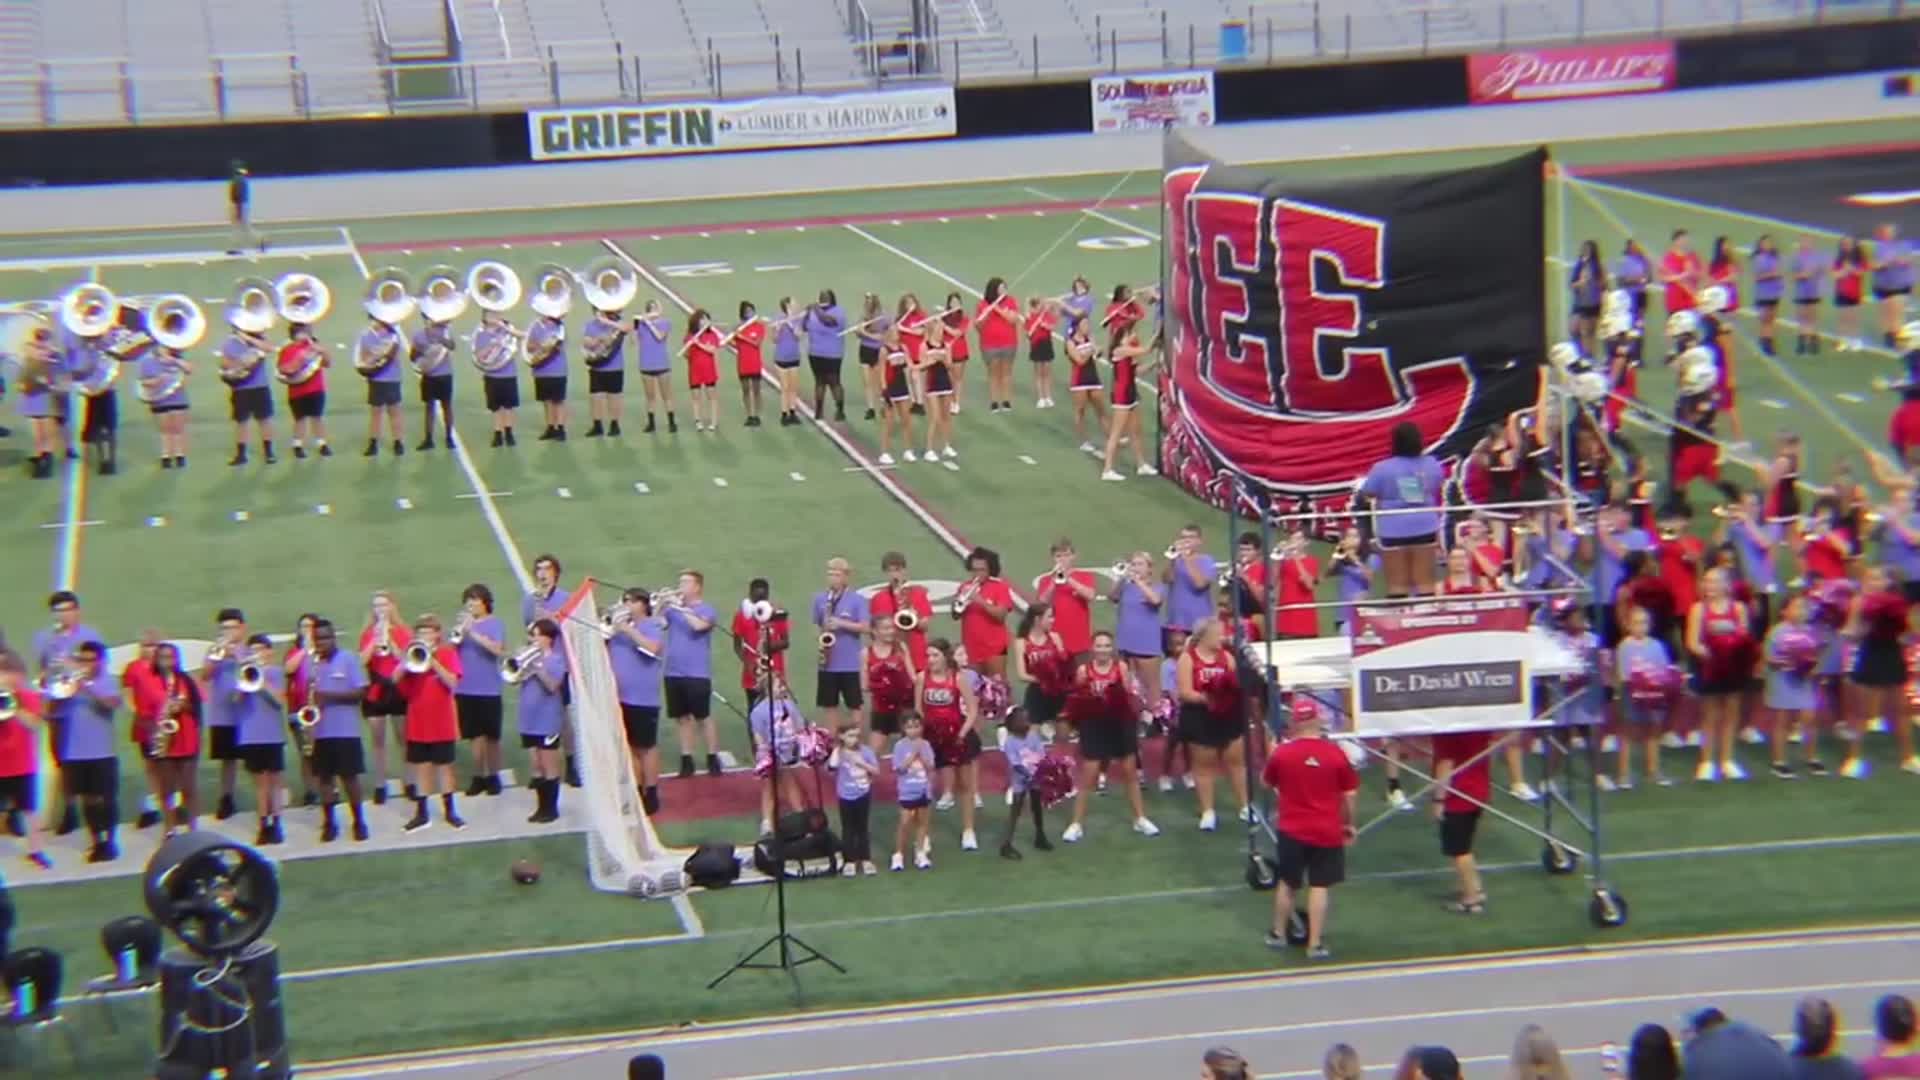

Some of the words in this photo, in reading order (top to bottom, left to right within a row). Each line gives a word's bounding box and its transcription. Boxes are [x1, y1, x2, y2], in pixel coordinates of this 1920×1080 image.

[540, 107, 713, 154] GRIFFIN
[737, 110, 808, 131] LUMBER
[827, 104, 928, 128] HARDWARE
[1375, 676, 1405, 694] Dr.
[1409, 672, 1459, 691] David
[1464, 670, 1513, 687] Wren
